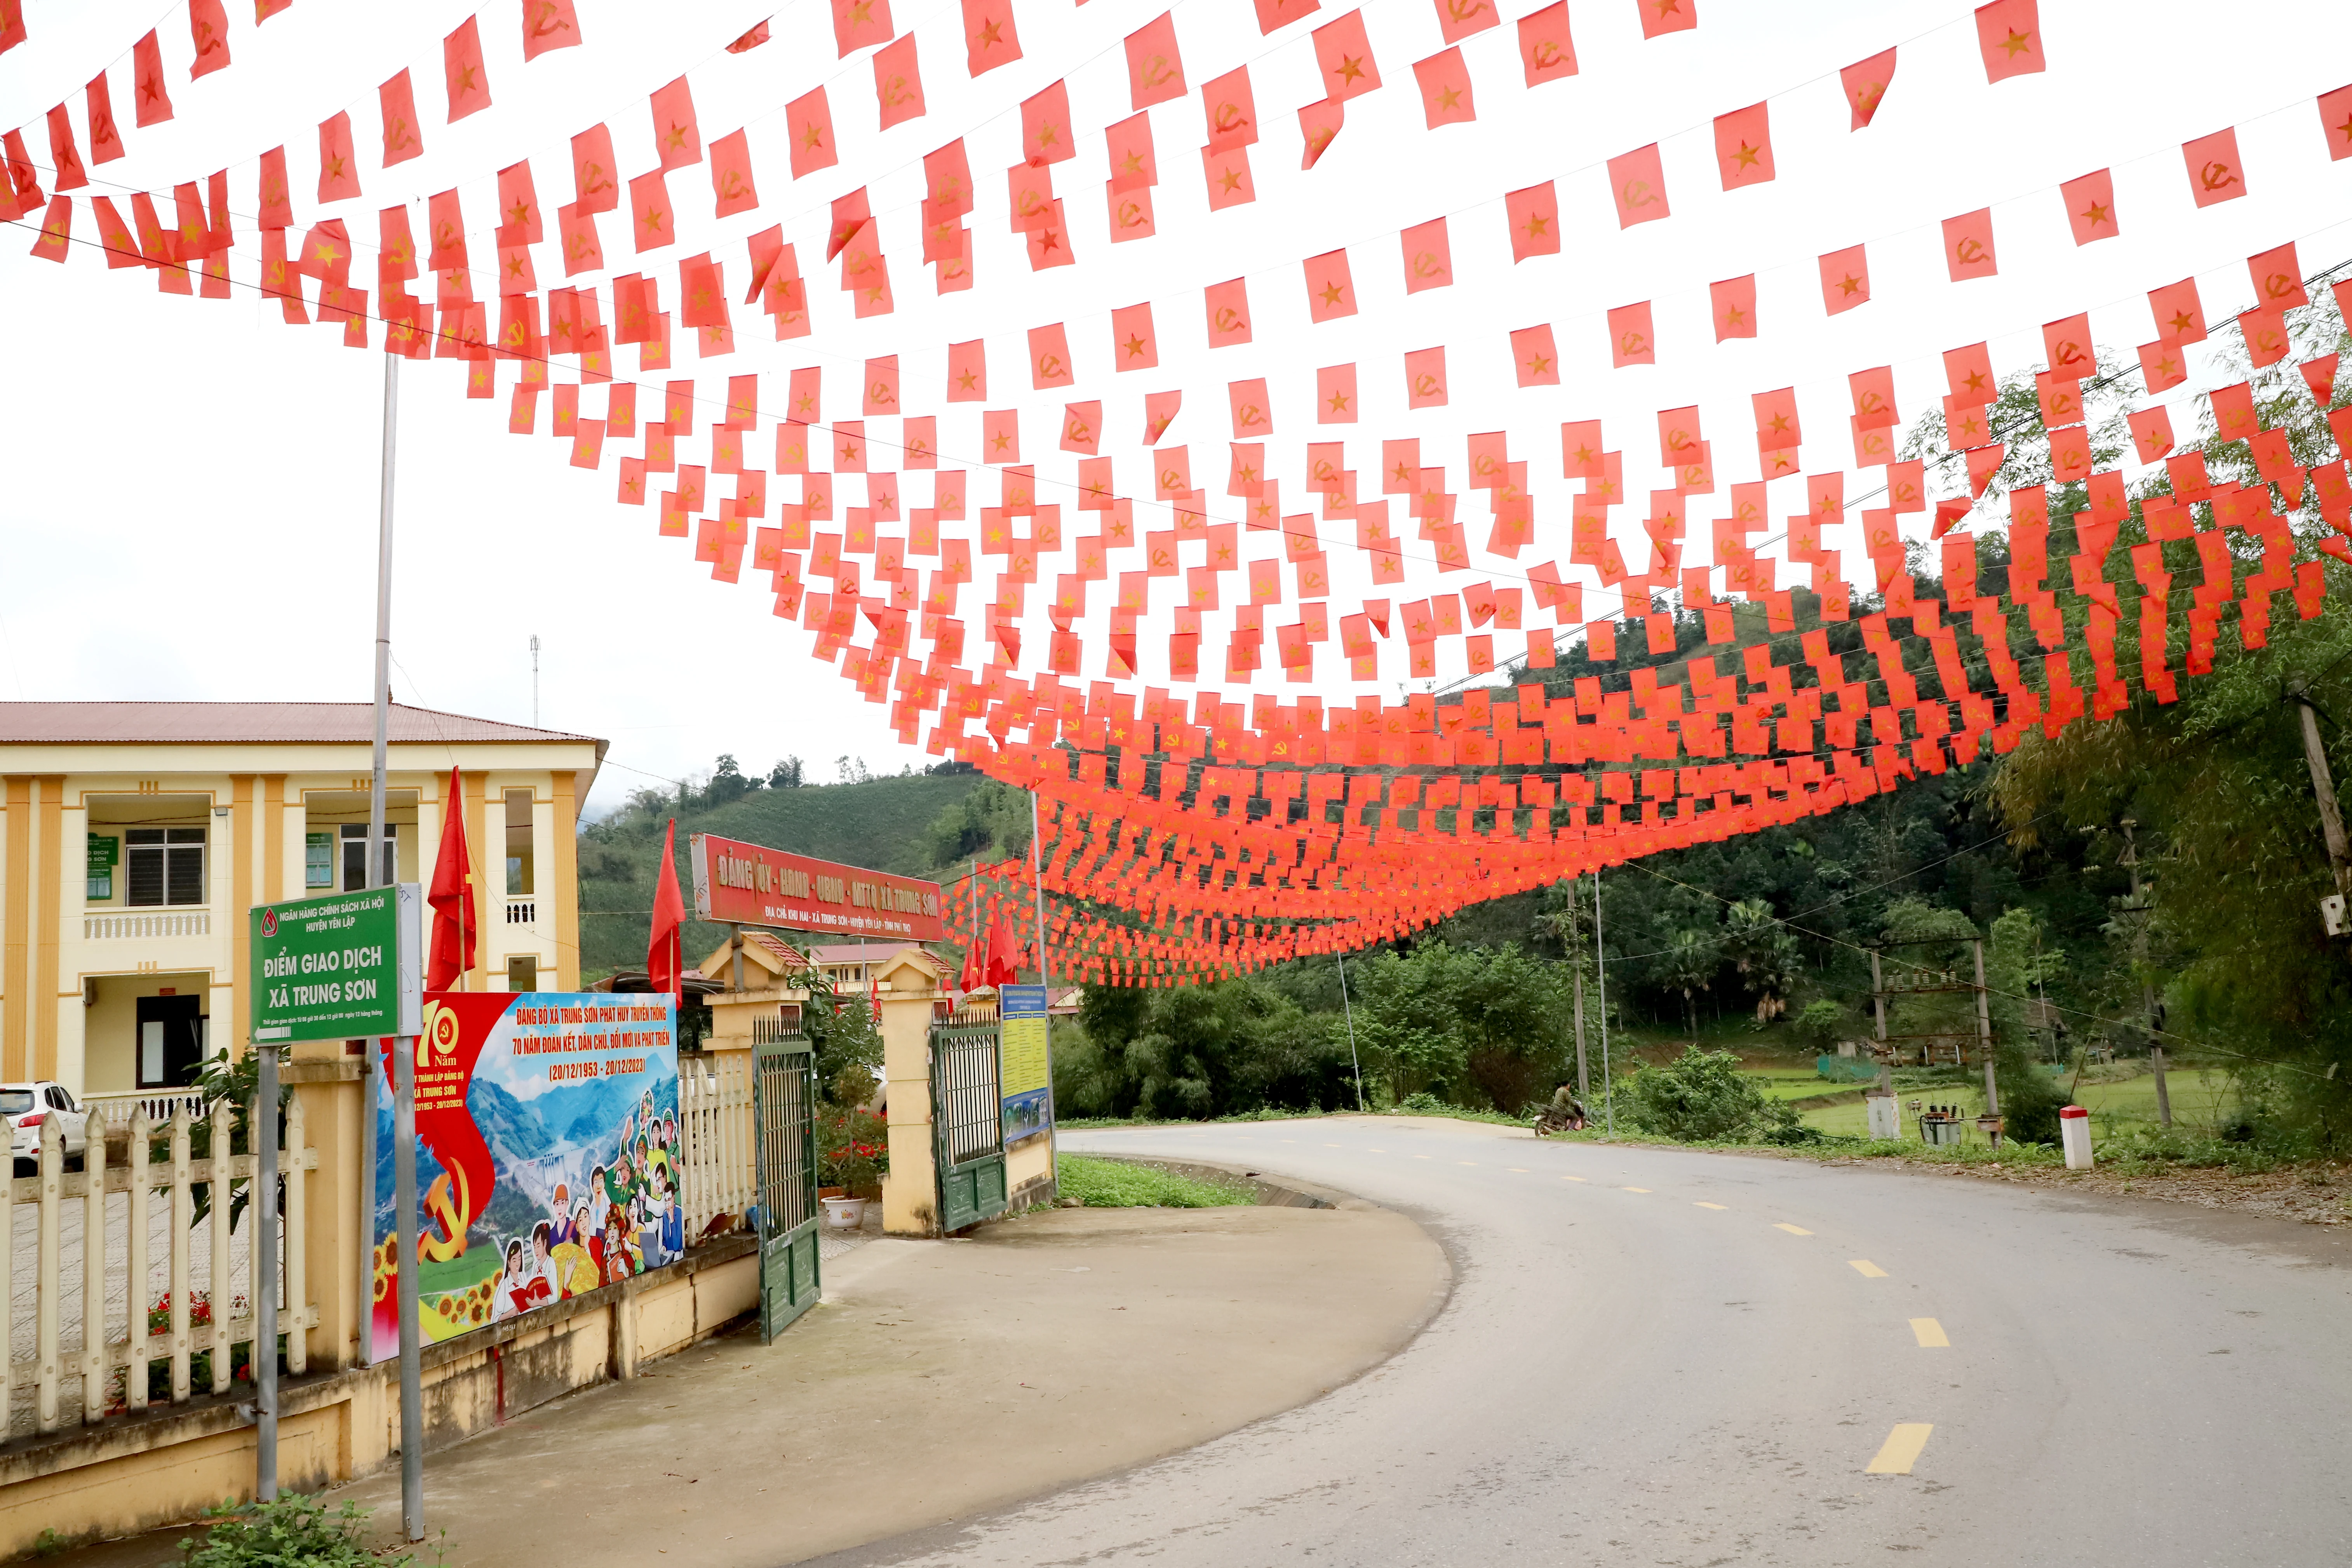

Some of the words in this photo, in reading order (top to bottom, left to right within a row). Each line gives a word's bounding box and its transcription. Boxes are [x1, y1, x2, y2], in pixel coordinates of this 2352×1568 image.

[717, 846, 753, 890] ĐẢNG
[757, 853, 771, 893] ỦY
[816, 875, 844, 904] UBND
[851, 881, 877, 912] MTTQ
[879, 882, 893, 911] XÃ
[893, 888, 920, 915] TRUNG
[922, 893, 938, 917] SƠN
[280, 909, 298, 922] NGÂN
[299, 907, 317, 919] HÀNG
[319, 903, 339, 916] CHÍNH
[341, 900, 359, 913] SÁCH
[360, 898, 370, 910] XÃ
[372, 895, 384, 910] HỘI
[765, 905, 775, 920] ĐỊA
[788, 909, 798, 921] KHU
[799, 910, 808, 922] NAI
[812, 911, 820, 924] XÃ
[821, 913, 837, 925] TRUNG
[838, 914, 848, 926] SƠN
[850, 915, 864, 931] HUYỆN
[865, 916, 874, 929] YÊN
[874, 917, 882, 932] LẬP
[903, 923, 911, 935] THỌ
[306, 919, 327, 933] HUYỆN
[329, 917, 341, 929] YÊN
[343, 915, 355, 929] LẬP
[264, 946, 297, 978] ĐIỂM
[301, 951, 339, 974] GIAO
[343, 945, 381, 974] DỊCH
[269, 983, 289, 1008] XÃ
[293, 983, 341, 1006] TRUNG
[345, 978, 376, 1001] SƠN
[517, 1003, 536, 1025] ĐẢNG
[538, 1005, 548, 1028] BỘ
[550, 1005, 559, 1024] XÃ
[561, 1008, 582, 1023] TRUNG
[584, 1006, 597, 1023] SƠN
[600, 1004, 615, 1022] PHÁT
[617, 1007, 629, 1022] HUY
[630, 1002, 649, 1021] TRUYỀN
[650, 1001, 666, 1021] THỐNG
[513, 1038, 522, 1055] 70
[524, 1034, 540, 1054] NĂM
[542, 1033, 561, 1053] ĐOÀN
[564, 1030, 576, 1053] KẾT,
[578, 1032, 592, 1051] DÂN
[594, 1029, 609, 1051] CHỦ,
[610, 1027, 620, 1048] ĐỔI
[622, 1030, 633, 1048] MỚI
[634, 1029, 641, 1047] VÀ
[642, 1029, 654, 1047] PHÁT
[655, 1025, 670, 1046] TRIỂN
[434, 1055, 457, 1067] Năm
[549, 1062, 597, 1082] (20/12/1953
[606, 1058, 645, 1075] 20/12/2023)
[418, 1073, 434, 1082] THÀNH
[435, 1072, 444, 1083] LẬP
[458, 1070, 464, 1081] BỘ
[422, 1086, 442, 1098] TRUNG
[444, 1084, 456, 1095] SƠN
[436, 1099, 463, 1109] 20/12/2023)
